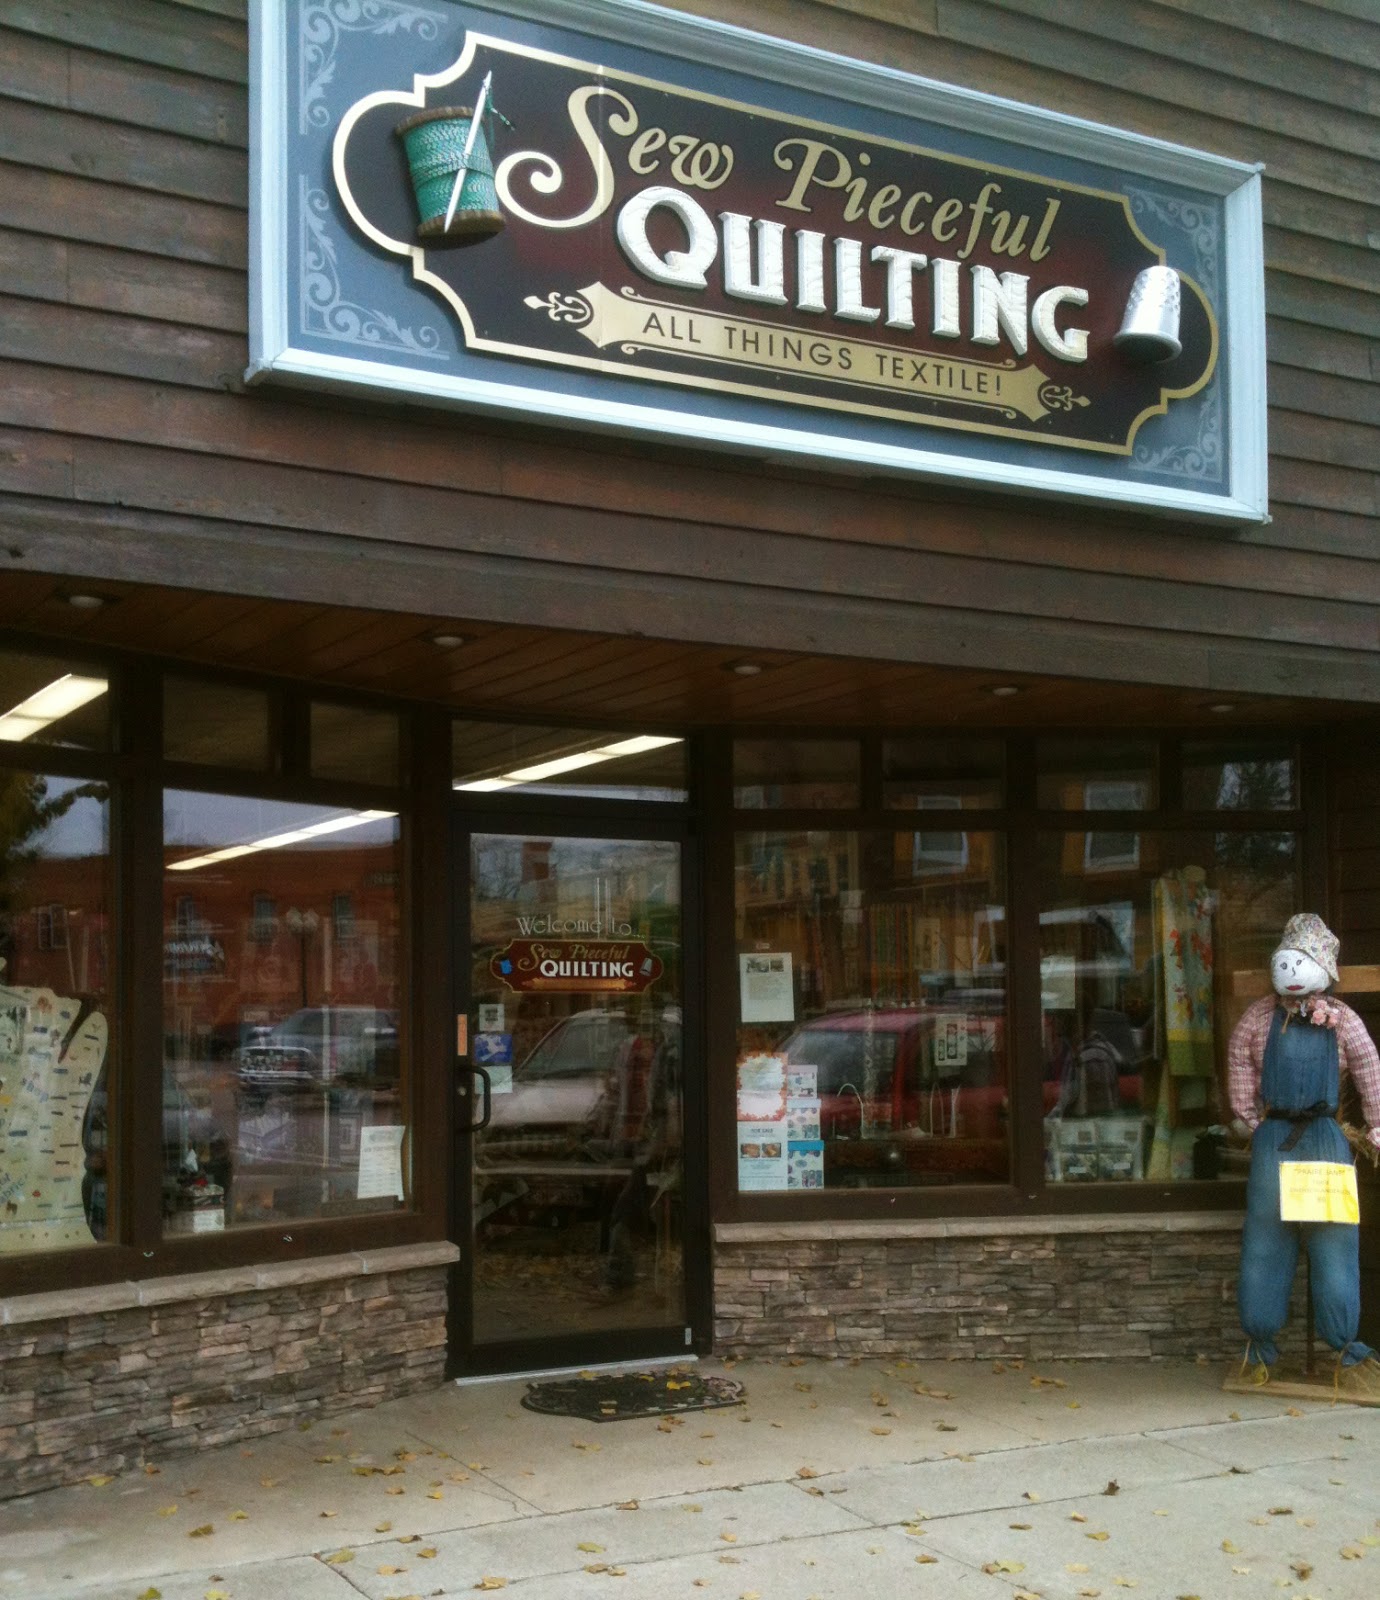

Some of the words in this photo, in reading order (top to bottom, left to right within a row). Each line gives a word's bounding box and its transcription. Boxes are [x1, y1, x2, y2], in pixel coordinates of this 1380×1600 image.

[495, 86, 734, 228] Sew
[774, 138, 1061, 261] Pieceful
[616, 186, 1090, 363] QUILTING
[642, 311, 701, 344] ALL
[723, 325, 853, 370] THINGS
[875, 353, 1001, 395] TEXTILE!
[516, 914, 601, 936] Welcome
[517, 943, 561, 971] Sew
[568, 944, 631, 960] Pieceful
[540, 960, 634, 977] QUILTING
